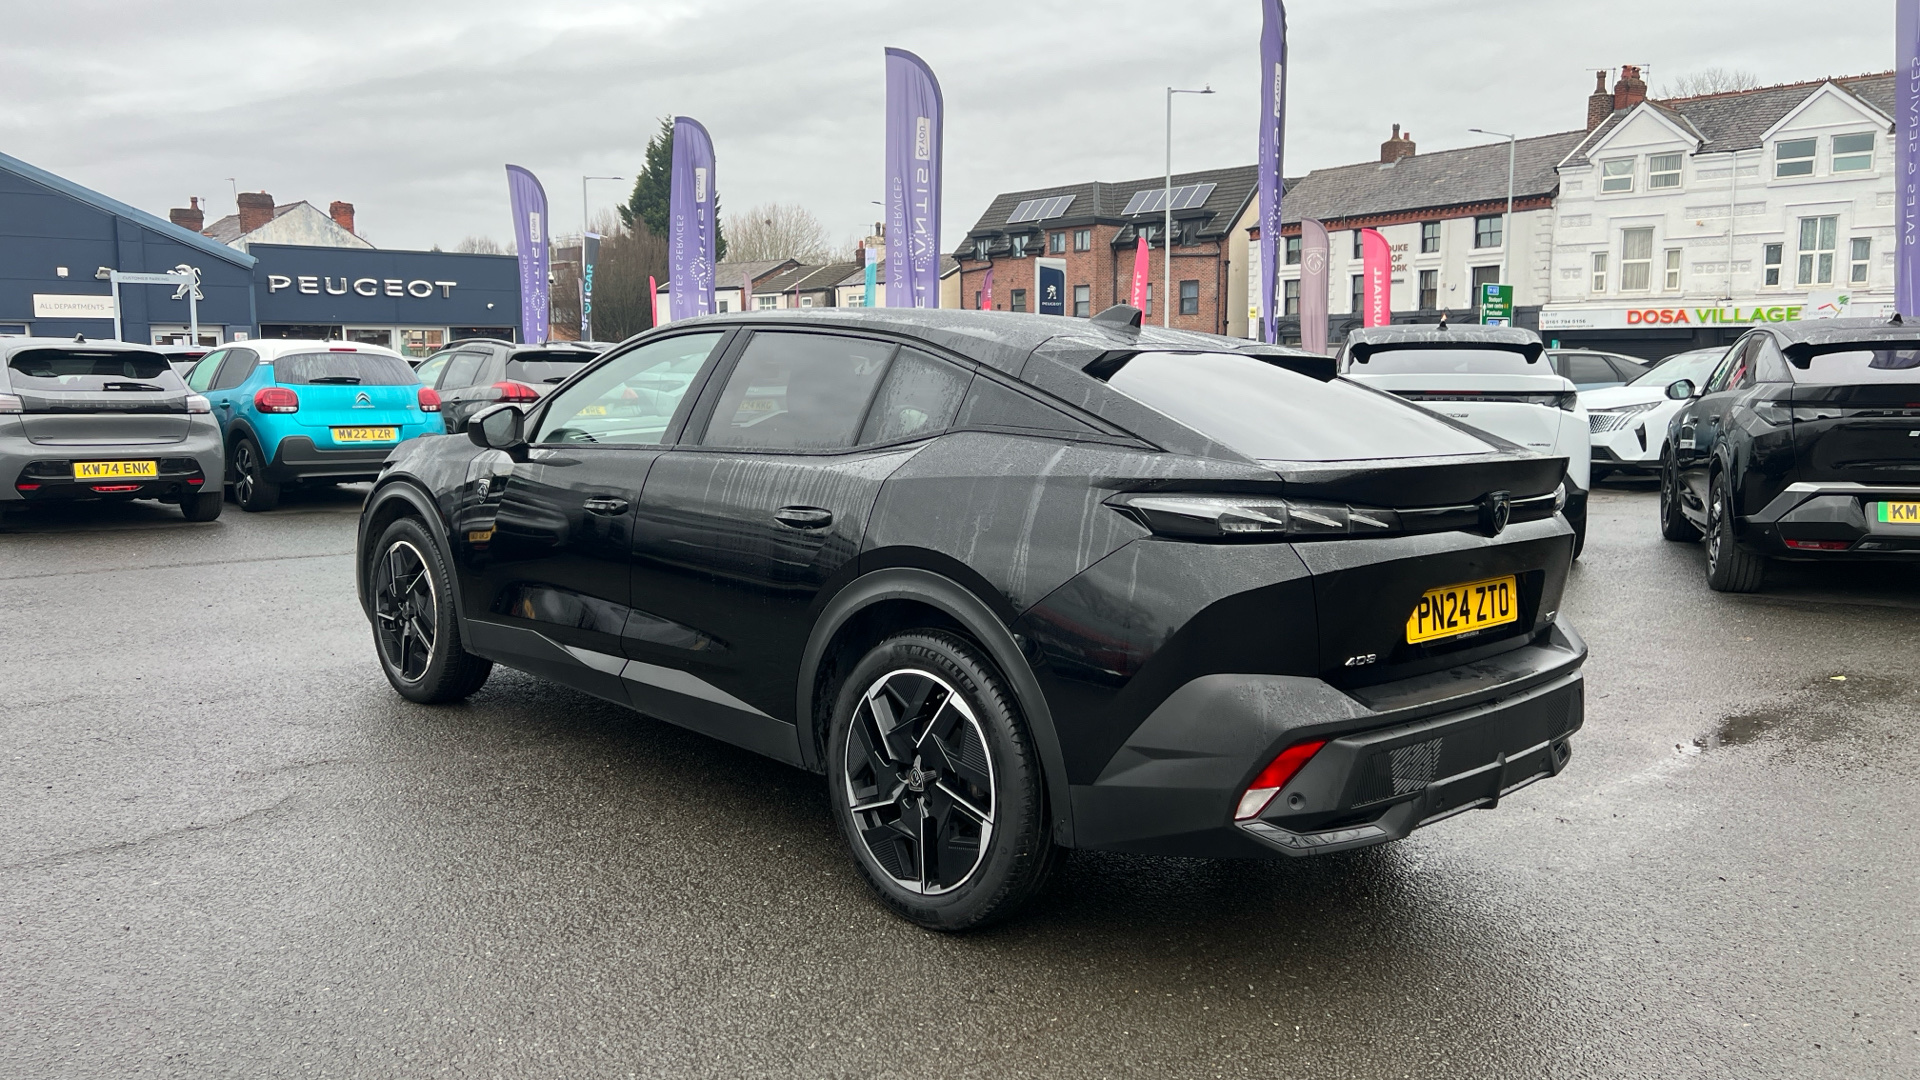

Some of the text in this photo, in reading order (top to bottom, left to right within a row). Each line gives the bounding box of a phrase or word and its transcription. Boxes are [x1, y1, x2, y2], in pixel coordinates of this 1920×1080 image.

[1391, 254, 1402, 263] OF
[267, 275, 457, 298] PEUGEOT
[54, 303, 105, 311] DEPARTMENTS
[1627, 306, 1803, 325] DOSA VILLAGE
[338, 429, 391, 439] MW22 TZR
[82, 462, 151, 476] KW74 ENK
[1892, 504, 1920, 520] KM
[1417, 589, 1471, 634] PN24
[1344, 653, 1377, 668] 408
